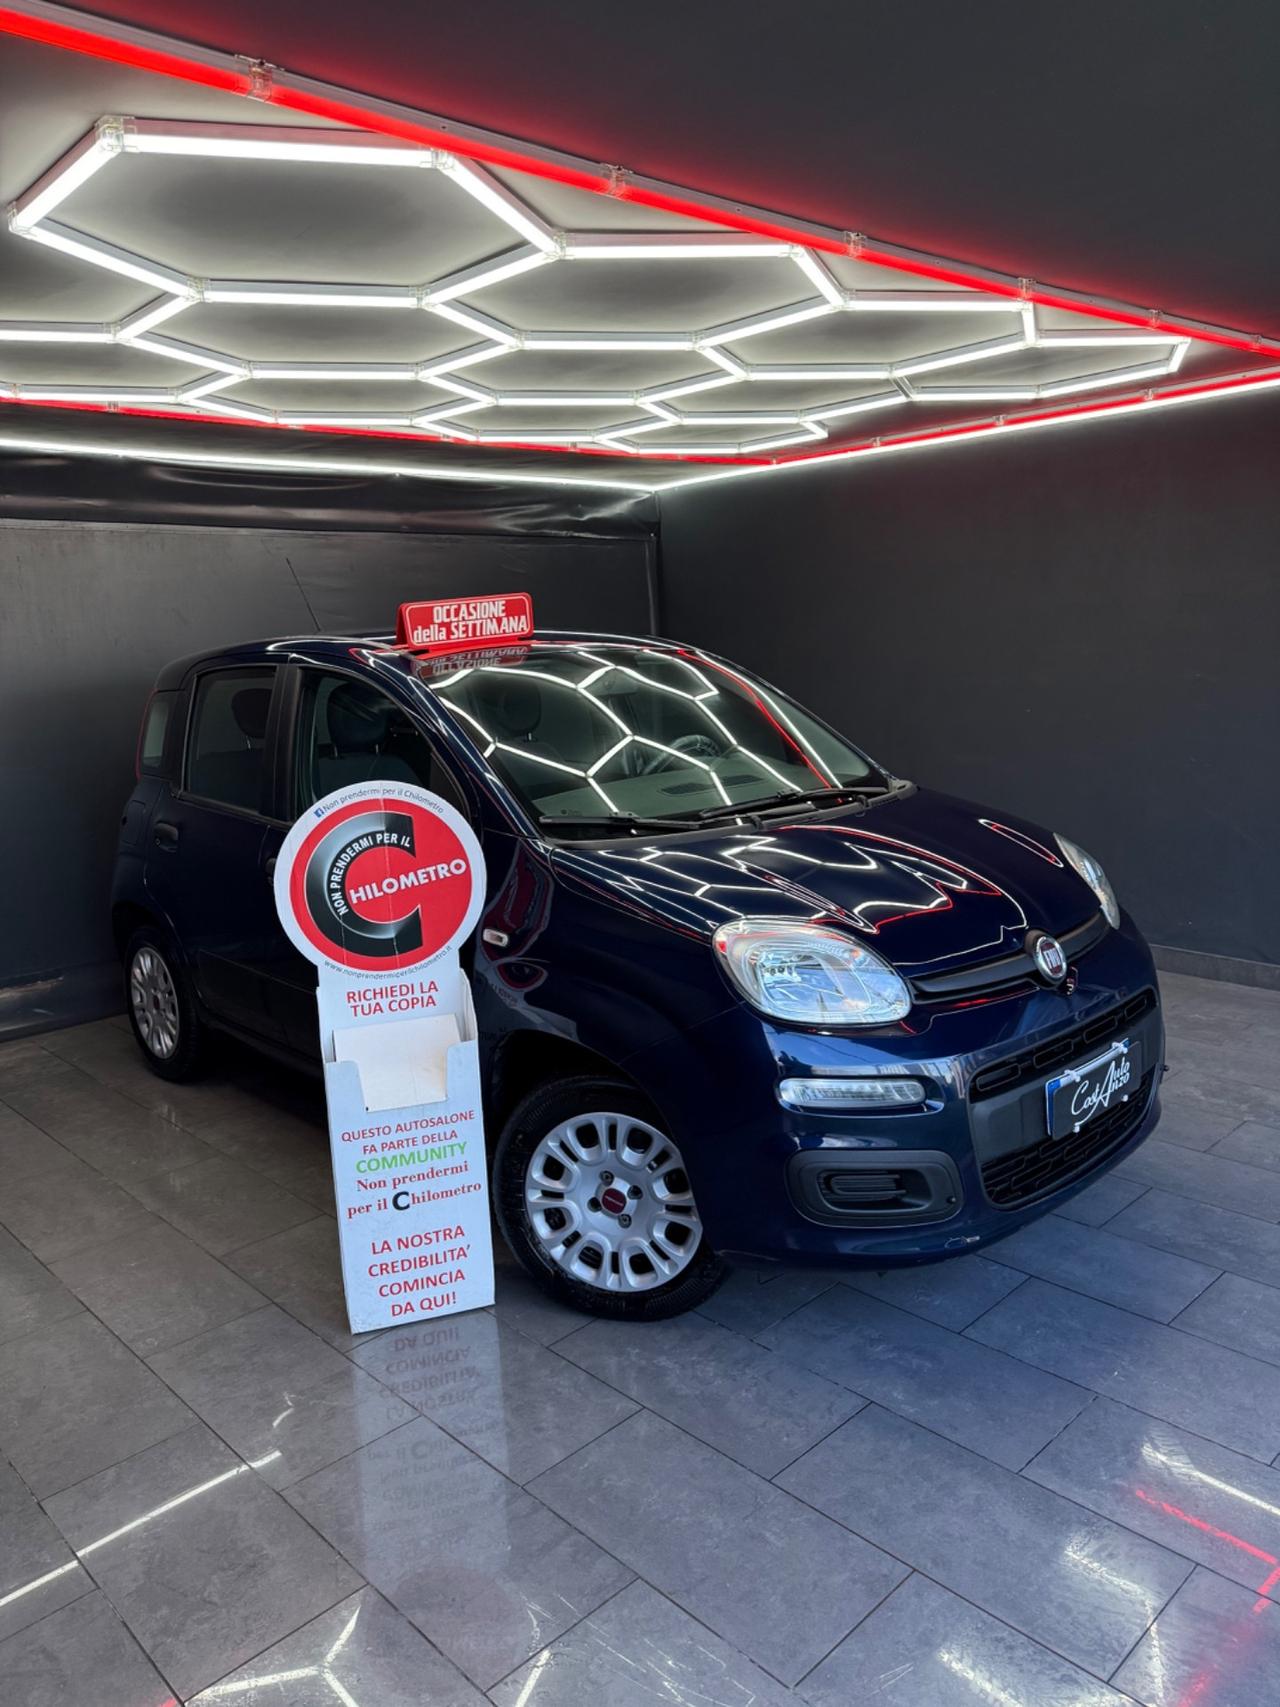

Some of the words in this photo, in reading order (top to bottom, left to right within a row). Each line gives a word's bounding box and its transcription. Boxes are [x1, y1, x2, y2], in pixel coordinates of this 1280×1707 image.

[433, 601, 506, 624] OCCASIONE
[413, 624, 446, 643] della
[450, 615, 527, 640] SETTIMANA
[323, 800, 339, 812] Non
[340, 788, 380, 804] prendermi
[382, 788, 396, 796] per
[404, 790, 444, 814] Chilometro
[376, 833, 398, 844] PER
[401, 836, 412, 848] IL
[330, 835, 373, 890] PRENDERMI
[332, 891, 349, 917] NON
[346, 983, 415, 1004] RICHIEDI
[419, 980, 439, 994] LA
[350, 1002, 384, 1018] TUA
[388, 994, 437, 1012] COPIA
[341, 1124, 392, 1143] QUESTO
[395, 1110, 475, 1134] AUTOSALONE
[362, 1142, 378, 1156] FA
[381, 1138, 418, 1152] PARTE
[422, 1129, 458, 1146] DELLA
[355, 1141, 468, 1174] COMMUNITY
[356, 1176, 387, 1192] Non
[392, 1160, 469, 1190] prendermi
[346, 1199, 373, 1219] per
[376, 1198, 388, 1211] il
[392, 1181, 482, 1212] Chilometro
[371, 1239, 392, 1256] LA
[397, 1225, 466, 1251] NOSTRA
[368, 1244, 471, 1278] CREDIBILITA'
[378, 1268, 466, 1298] COMINCIA
[391, 1301, 416, 1318] DA
[420, 1292, 457, 1312] QUI!
